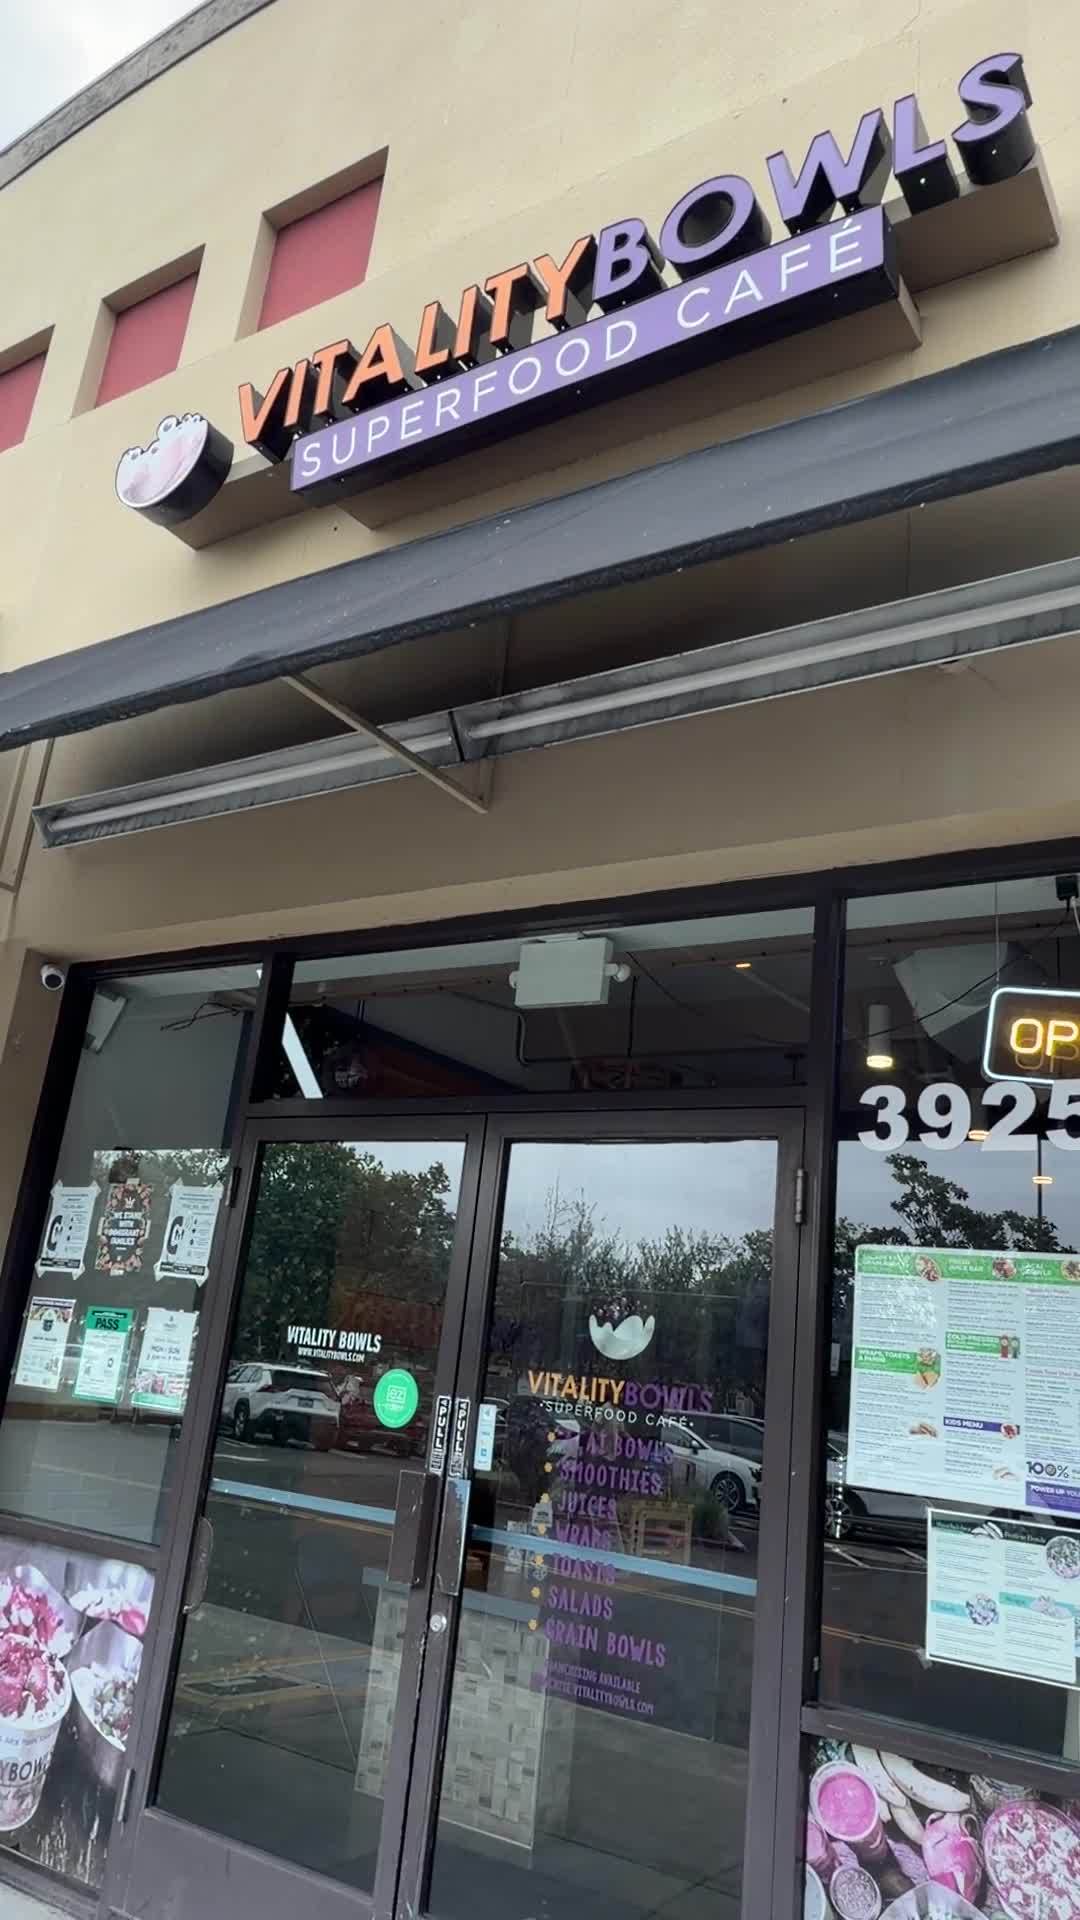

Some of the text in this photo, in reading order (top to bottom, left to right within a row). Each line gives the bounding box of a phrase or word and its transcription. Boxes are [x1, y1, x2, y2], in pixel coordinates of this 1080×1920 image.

[301, 219, 865, 478] SUPERFOOD CAFÉ
[857, 1081, 1080, 1152] 3925
[95, 1318, 120, 1331] PASS
[286, 1325, 383, 1353] VITALITY BOWLS
[435, 1406, 448, 1449] PULL
[455, 1409, 467, 1452] PULL
[545, 1401, 689, 1428] SUPERFOOD CAFÉ
[613, 1432, 674, 1465] BOWLS
[559, 1457, 663, 1496] SMOOTHIES
[556, 1489, 618, 1521] JUICES
[548, 1585, 614, 1621] SALADS
[544, 1617, 667, 1669] GRAIN BOWLS
